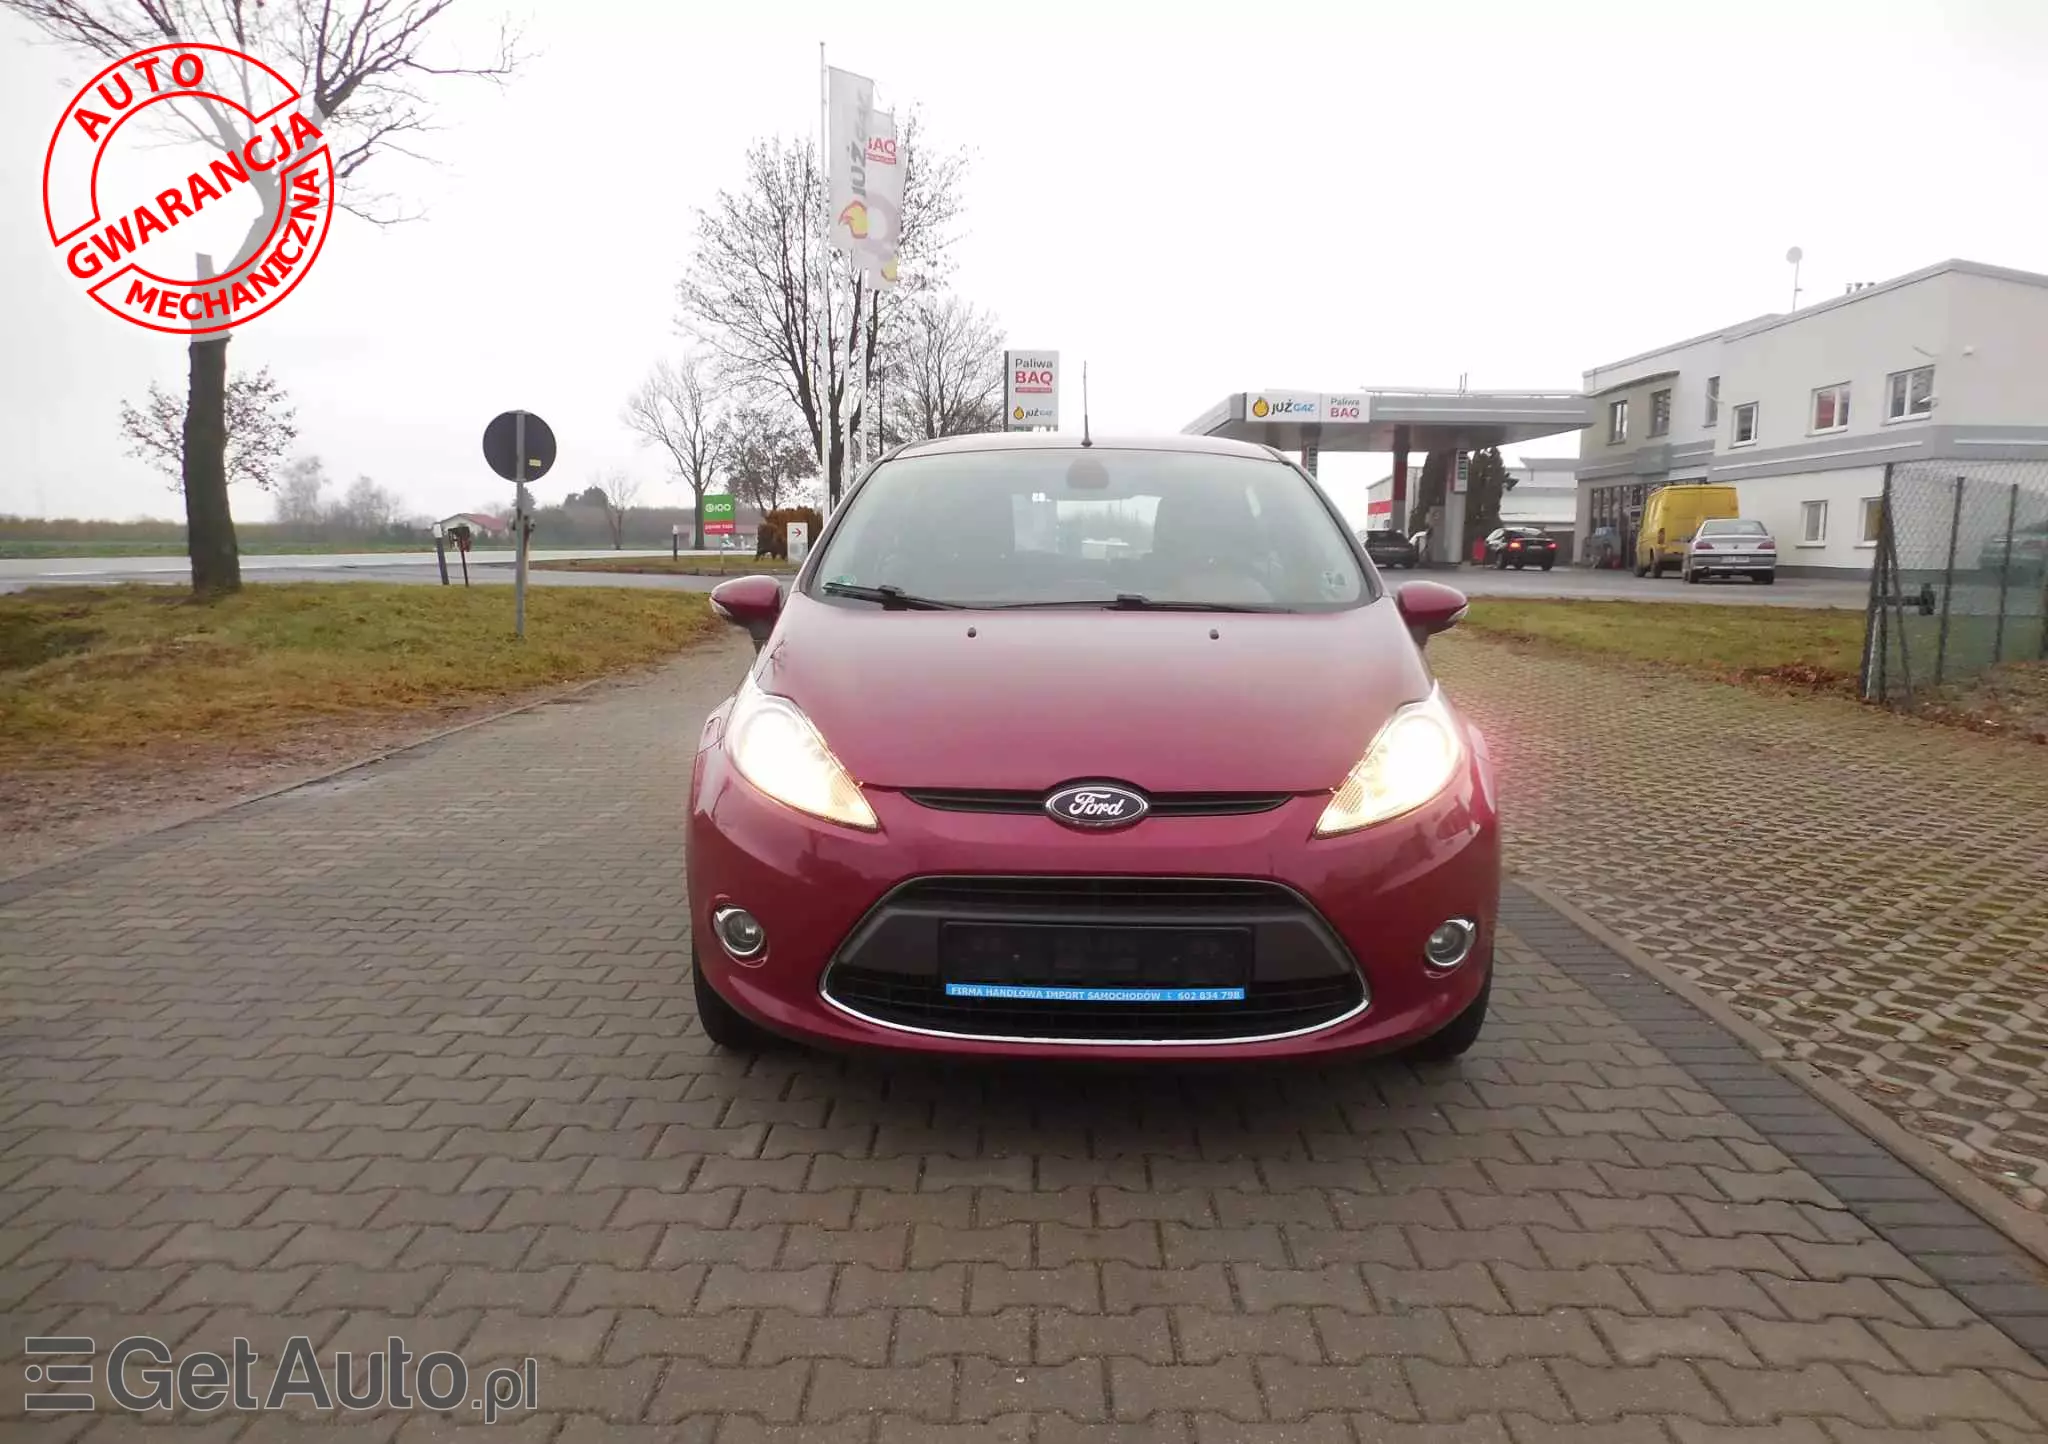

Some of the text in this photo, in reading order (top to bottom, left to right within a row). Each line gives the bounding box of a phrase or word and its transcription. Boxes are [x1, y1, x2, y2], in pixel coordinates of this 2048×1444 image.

[1015, 358, 1053, 369] Paliwa
[1015, 371, 1053, 385] BAQ
[1330, 407, 1360, 418] BAQ
[1069, 792, 1125, 815] Ford
[951, 986, 982, 997] FIRMA
[986, 987, 1042, 999] HANDLOWA
[1046, 990, 1085, 1000] IMPORT
